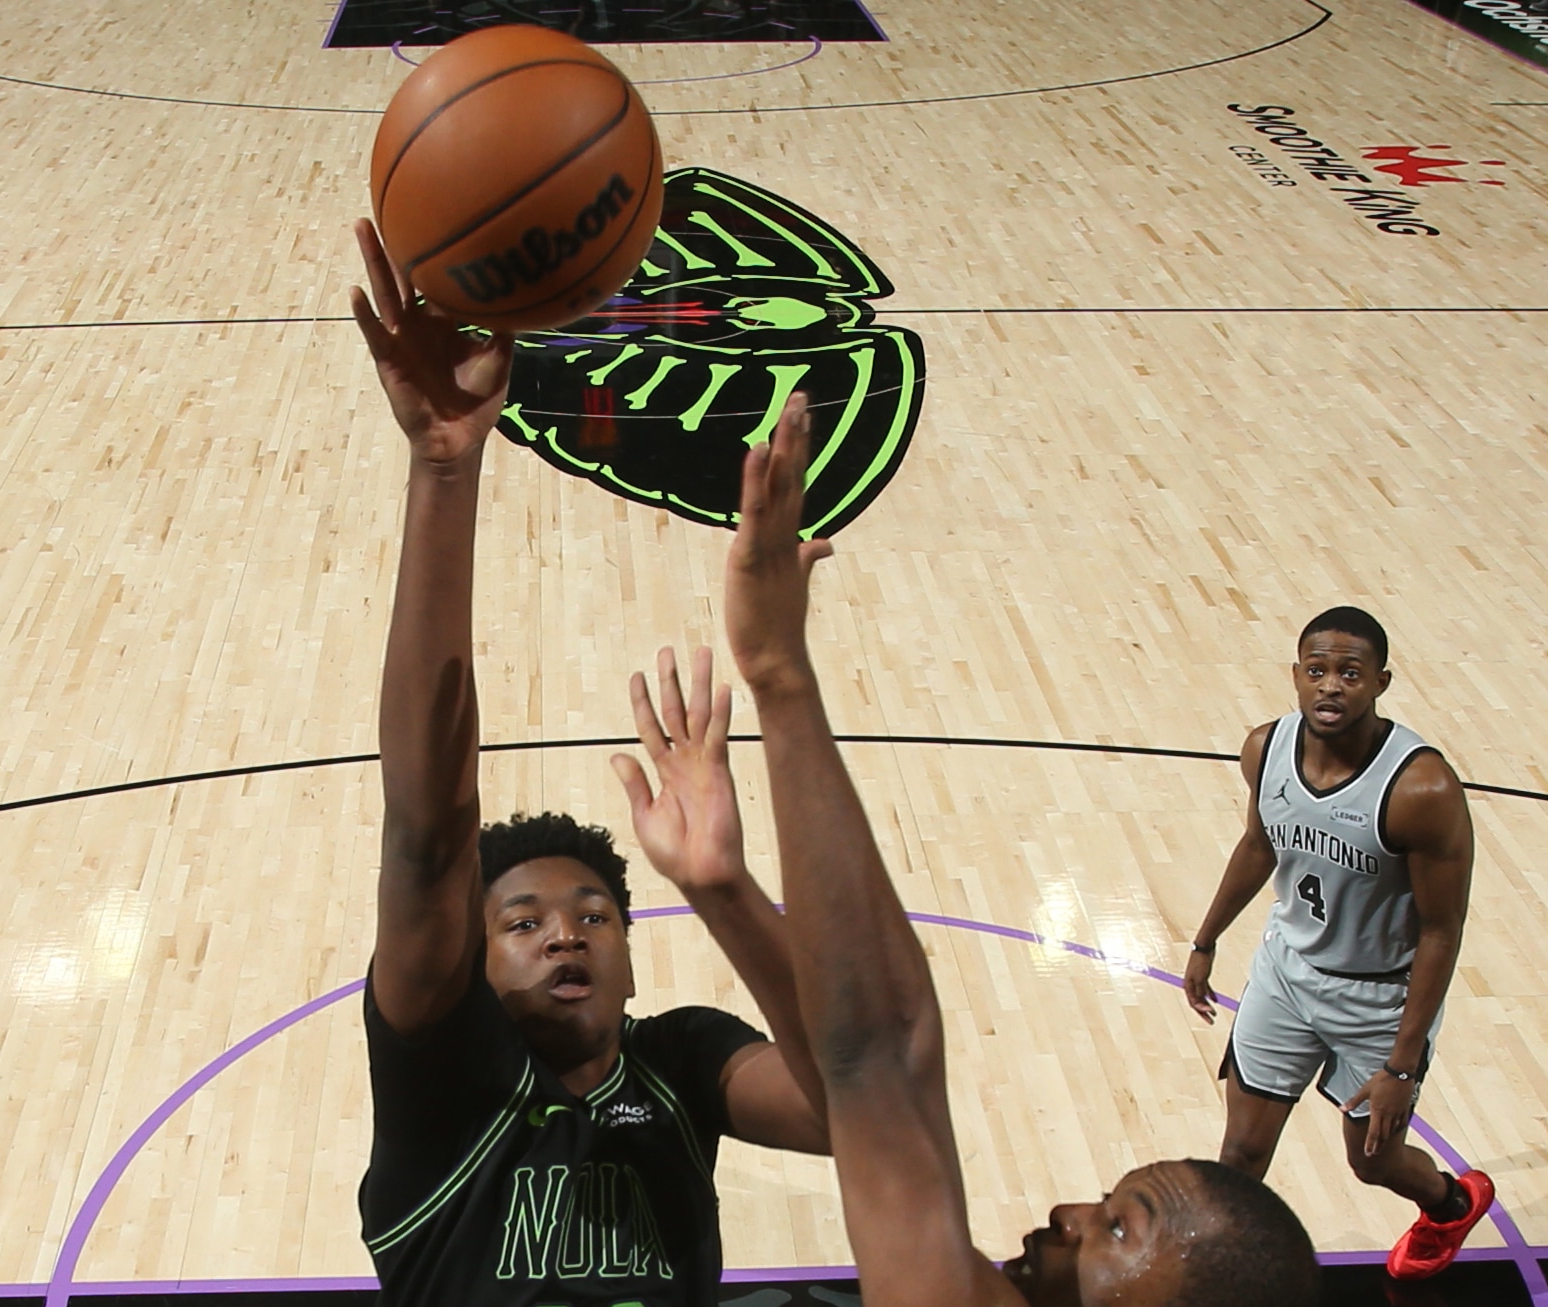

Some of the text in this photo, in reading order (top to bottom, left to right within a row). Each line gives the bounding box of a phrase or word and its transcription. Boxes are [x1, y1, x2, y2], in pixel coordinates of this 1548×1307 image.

[1227, 103, 1372, 183] SMOOTHIE
[1228, 144, 1298, 189] CENTER
[445, 172, 636, 303] Wilson
[1334, 810, 1364, 823] LEDGER
[1291, 823, 1379, 876] ANTONIO
[1296, 872, 1328, 924] 4
[610, 1114, 653, 1127] ODUCTS
[495, 1161, 674, 1280] NOLA
